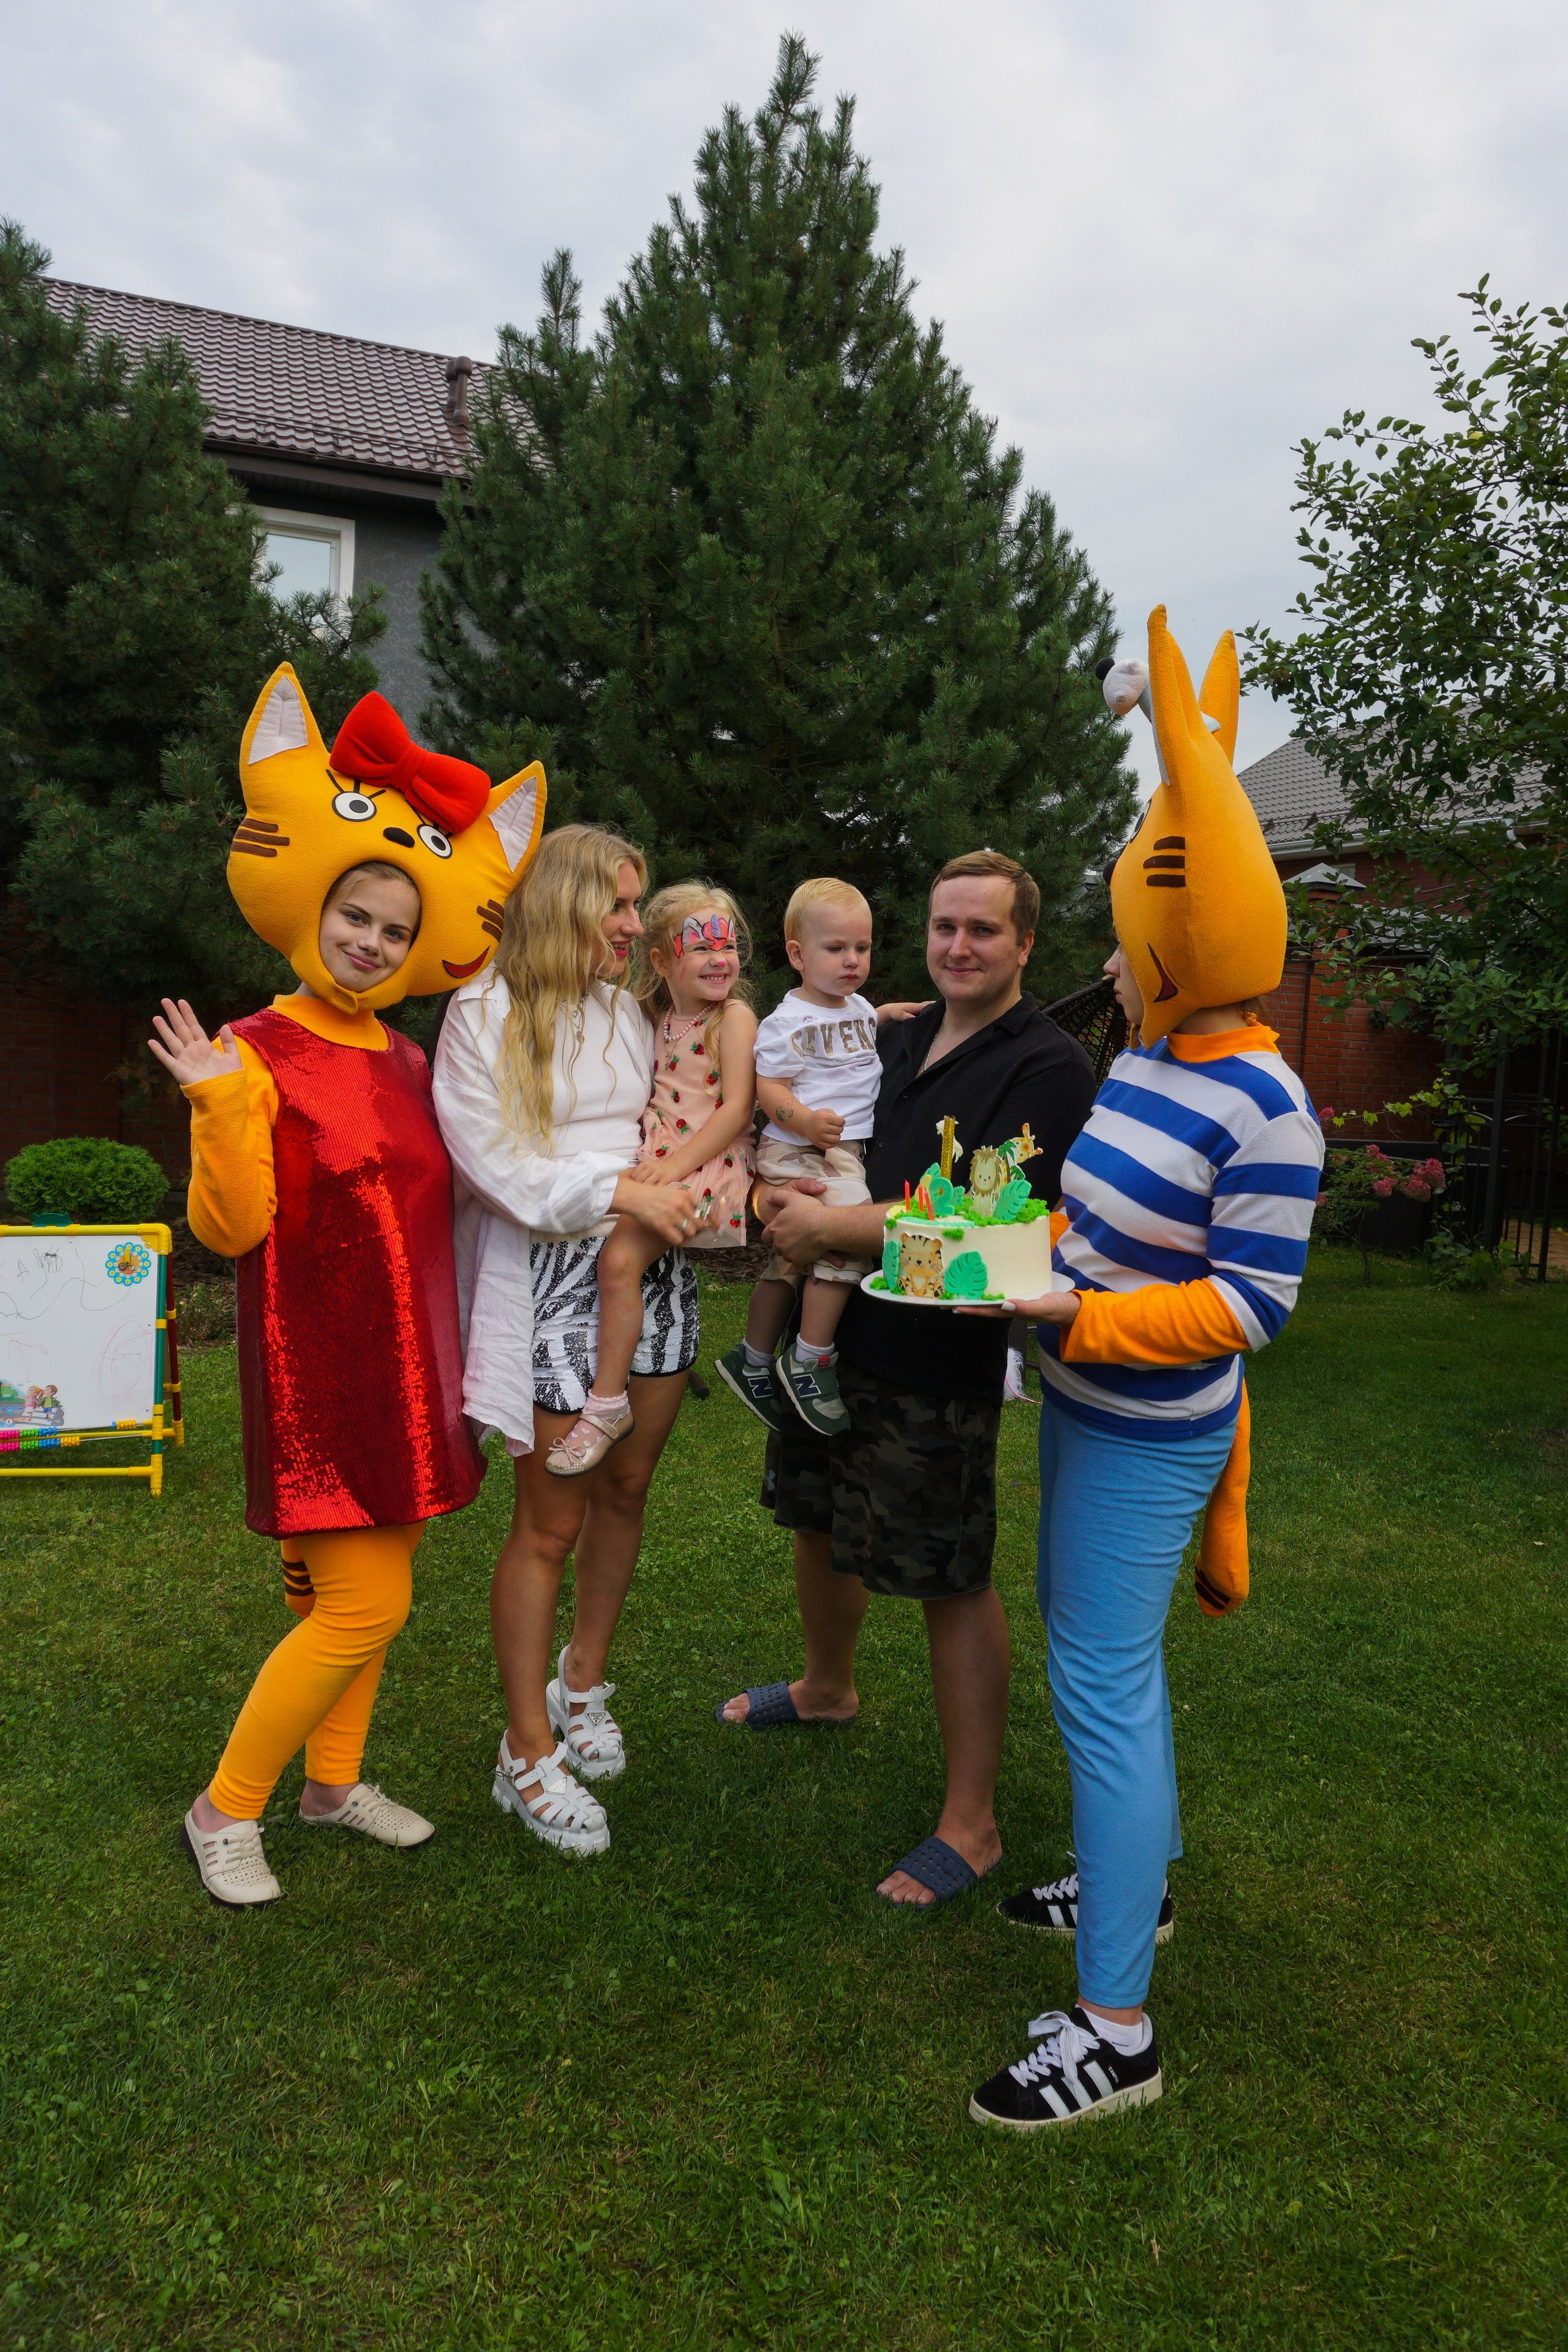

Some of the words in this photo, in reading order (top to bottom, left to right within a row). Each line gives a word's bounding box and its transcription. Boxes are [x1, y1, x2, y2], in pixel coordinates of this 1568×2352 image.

[929, 1177, 955, 1216] 2
[747, 1376, 774, 1398] N
[793, 1373, 821, 1398] N
